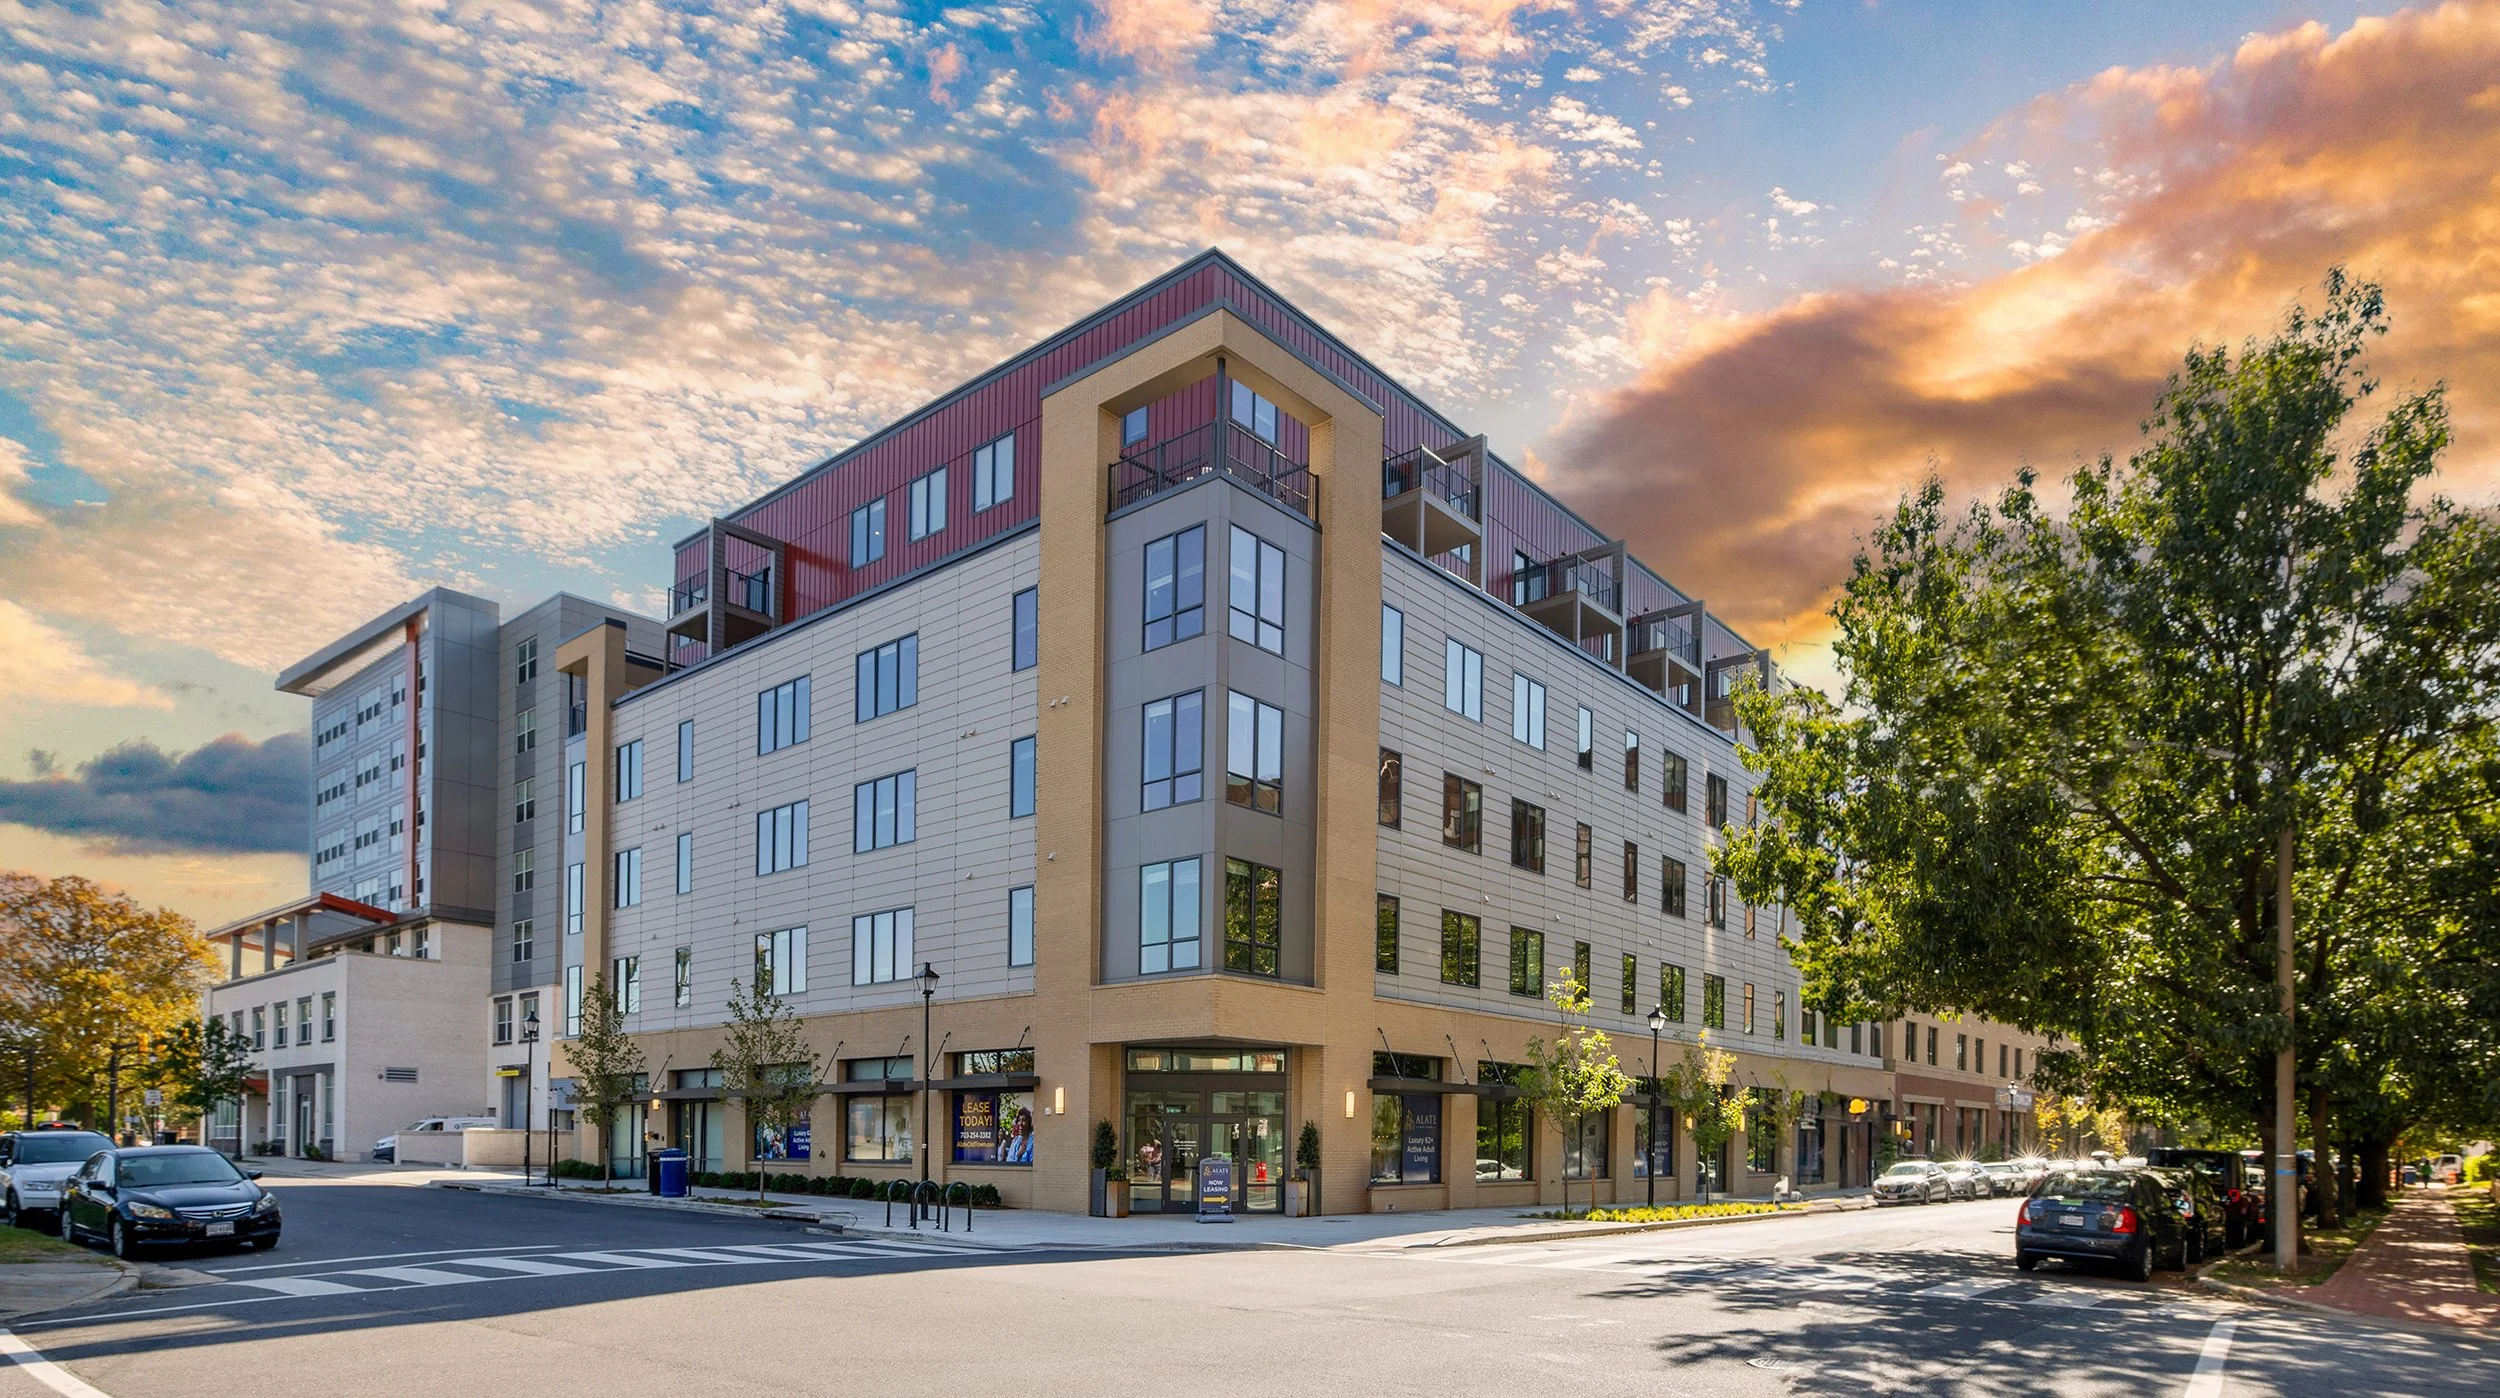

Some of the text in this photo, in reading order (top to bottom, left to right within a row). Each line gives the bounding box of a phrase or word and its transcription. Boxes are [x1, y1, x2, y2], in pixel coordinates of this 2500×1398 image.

[962, 1102, 990, 1112] LEASE
[960, 1116, 992, 1126] TODAY!
[1416, 1115, 1437, 1124] ALATE
